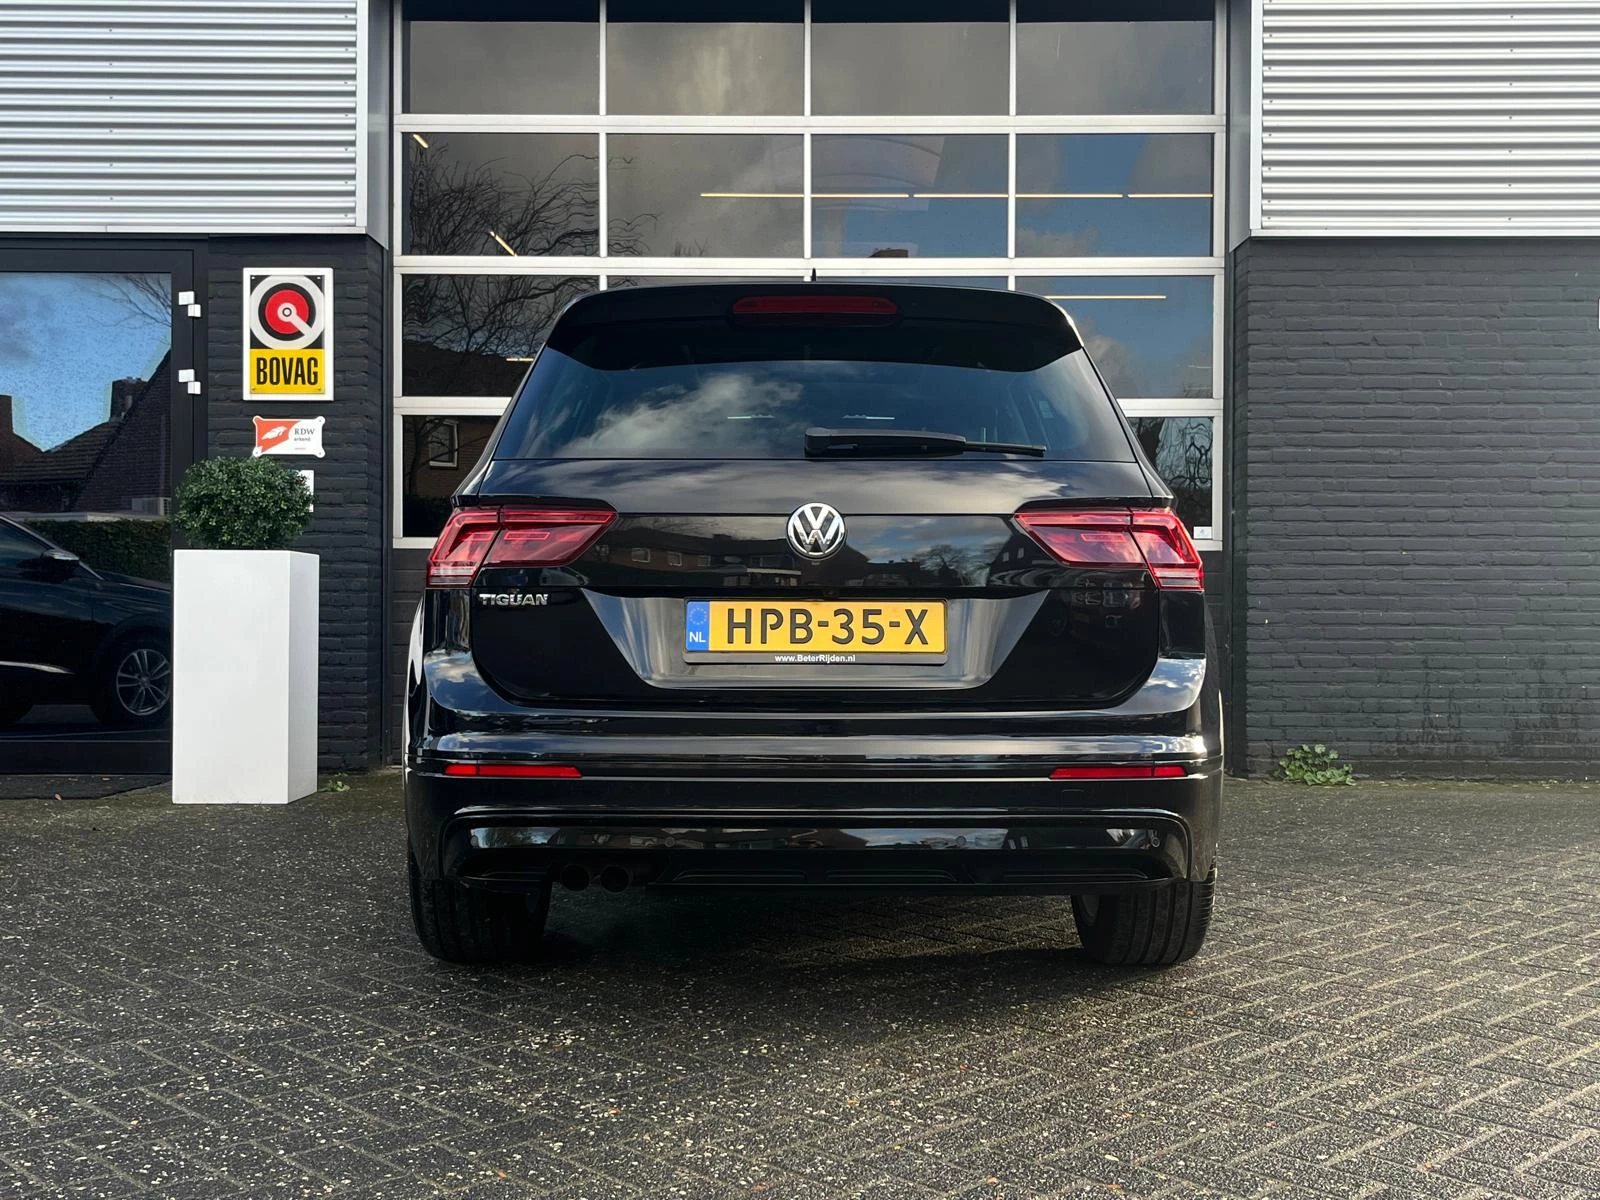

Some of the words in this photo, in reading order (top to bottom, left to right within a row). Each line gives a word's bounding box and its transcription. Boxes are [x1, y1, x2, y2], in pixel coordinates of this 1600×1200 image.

[256, 357, 318, 385] BOVAG
[479, 593, 548, 606] TIGUAN
[727, 608, 929, 645] HPB-35-X
[689, 632, 706, 643] NL
[774, 654, 856, 664] www.BeterRijden.nl
